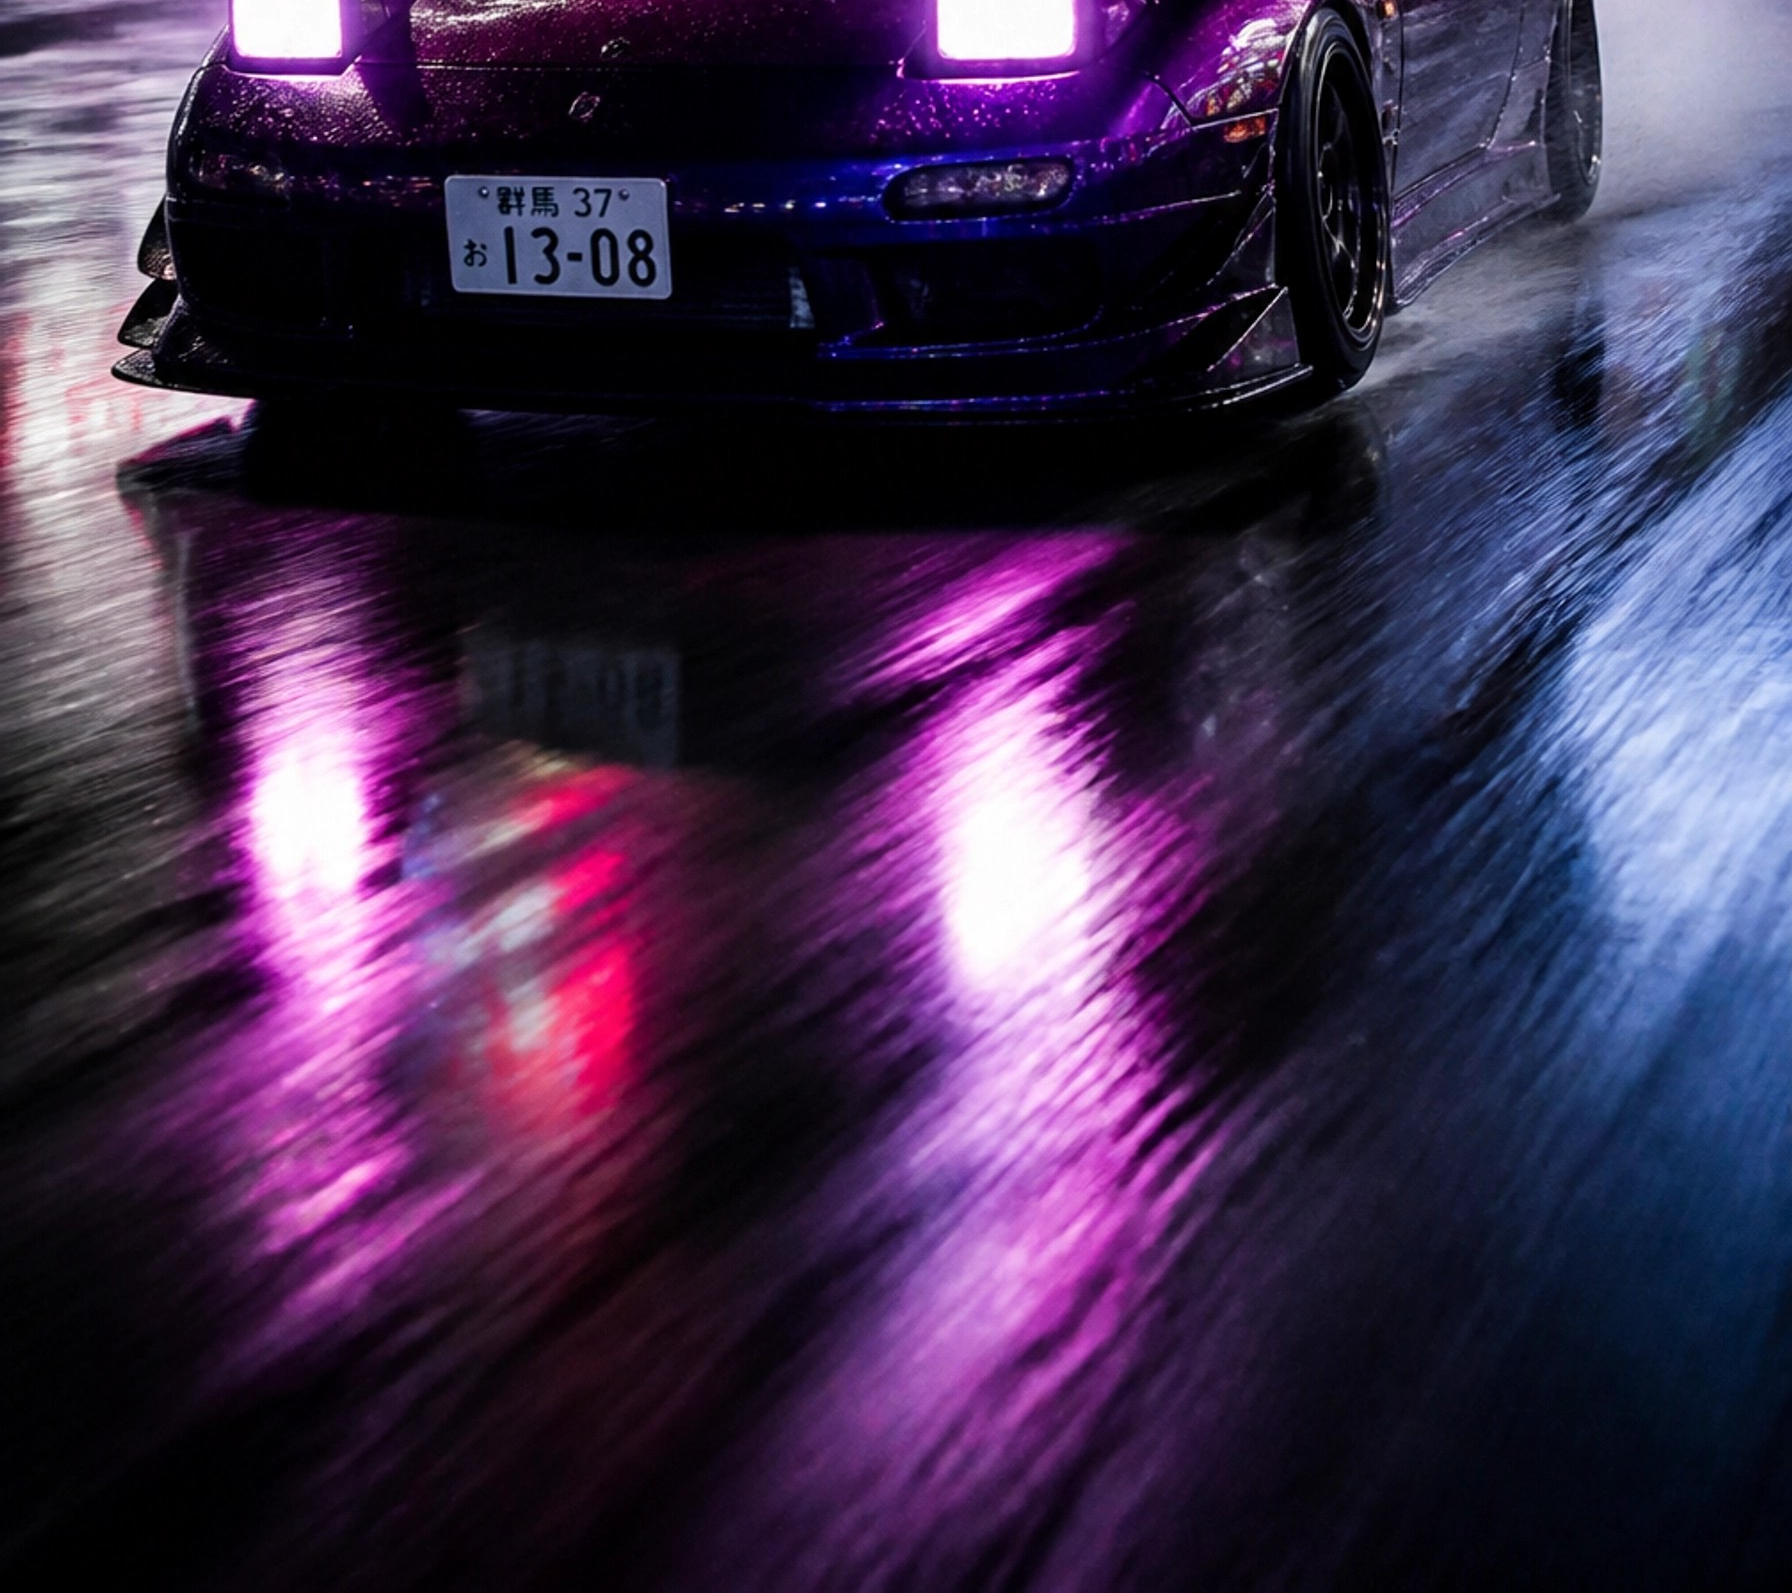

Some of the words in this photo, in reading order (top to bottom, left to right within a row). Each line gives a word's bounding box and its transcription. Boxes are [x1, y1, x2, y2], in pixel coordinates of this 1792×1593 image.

[496, 186, 560, 218] 群馬
[572, 187, 613, 218] 37
[463, 238, 488, 268] お
[504, 225, 657, 288] 13-08
